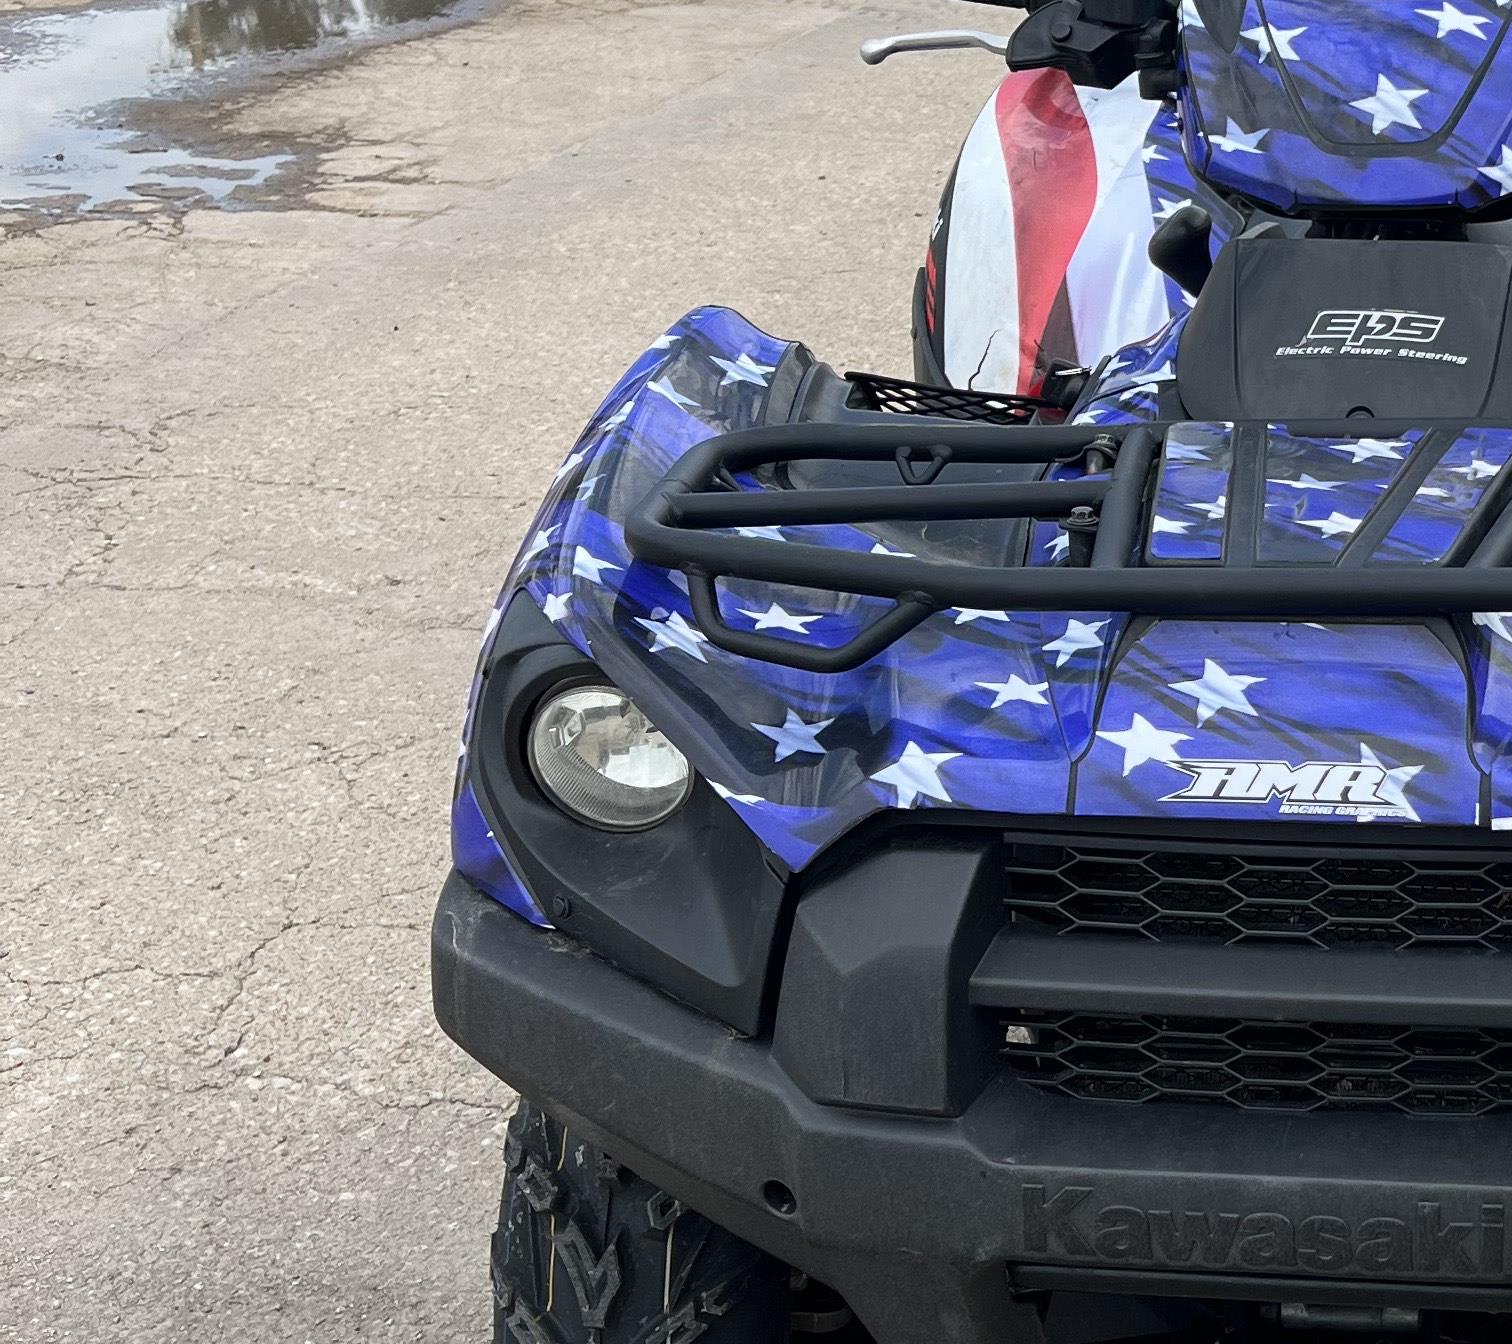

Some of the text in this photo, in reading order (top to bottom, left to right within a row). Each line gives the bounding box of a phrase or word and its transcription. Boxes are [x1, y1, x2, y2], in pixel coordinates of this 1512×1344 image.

[1306, 310, 1446, 346] EPS
[1275, 346, 1469, 365] Electric Power Steering
[1160, 758, 1398, 805] AMR
[1278, 804, 1333, 816] RACING
[1020, 1183, 1504, 1273] Kawasaki
